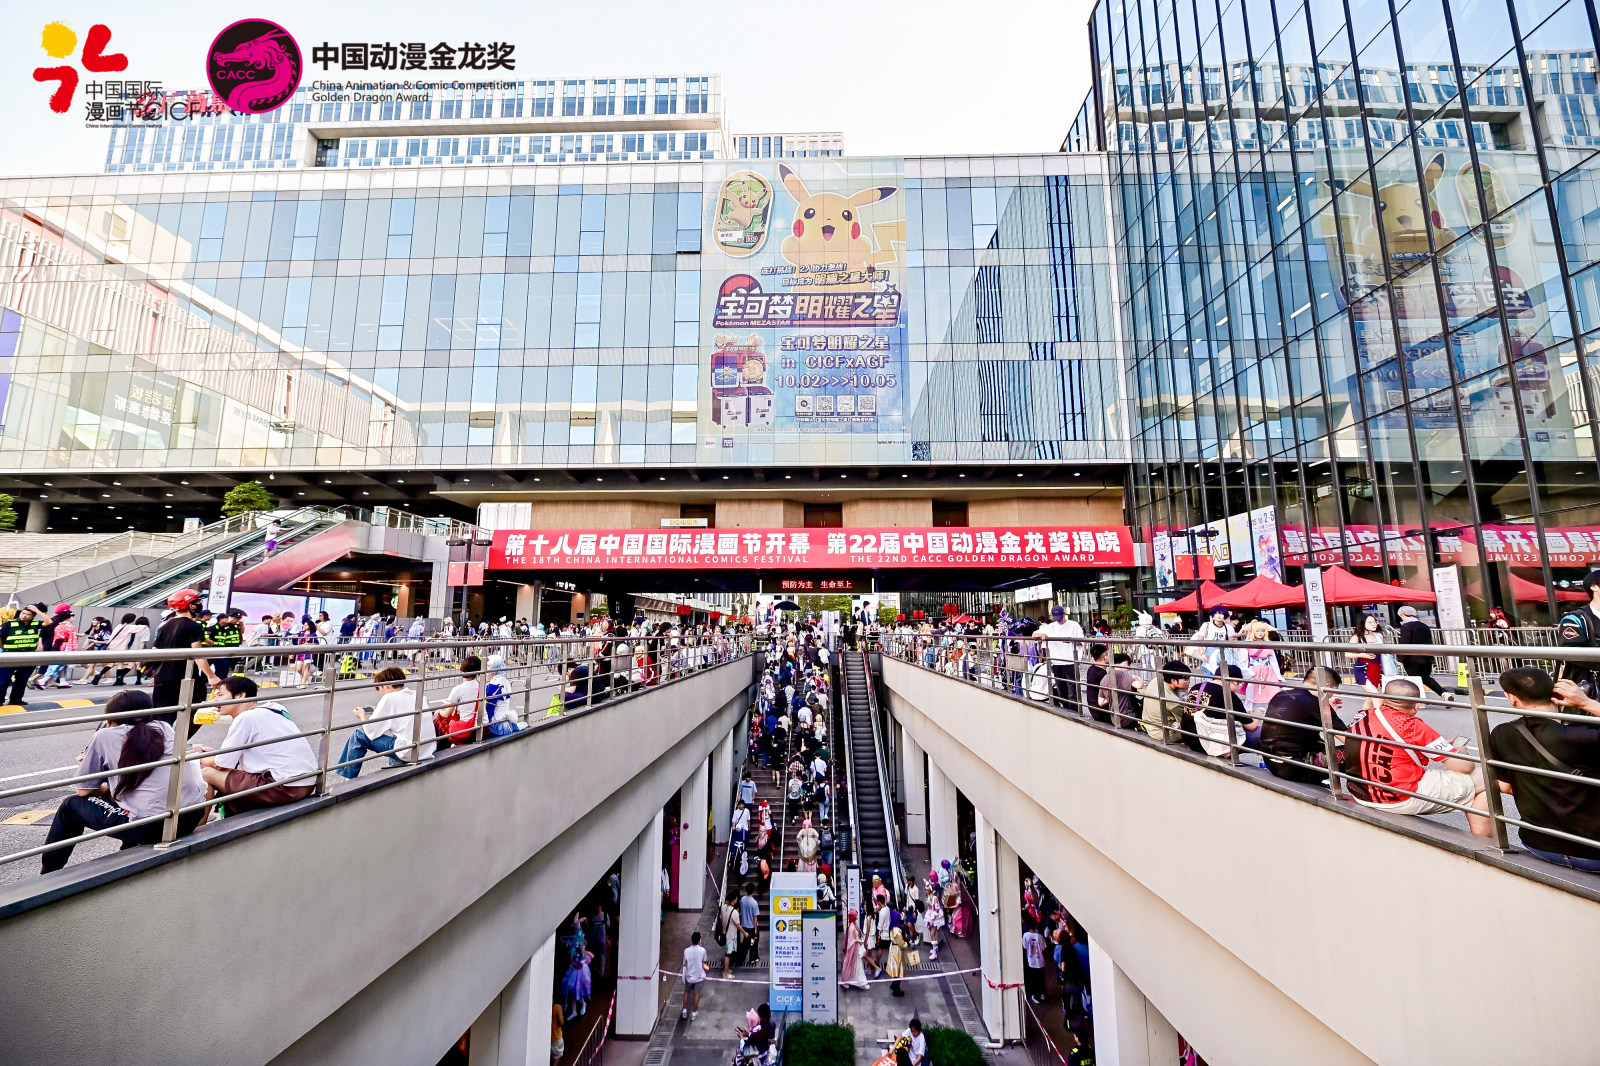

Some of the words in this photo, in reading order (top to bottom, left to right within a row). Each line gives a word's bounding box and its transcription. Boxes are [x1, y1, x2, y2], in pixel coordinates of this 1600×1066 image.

[718, 293, 899, 319] 宝可梦明耀之星
[781, 335, 890, 351] 宝可梦明耀之星
[782, 355, 796, 368] in
[805, 354, 890, 369] CICFxAGF
[504, 532, 811, 555] 第十八届中国国际漫画节开幕
[827, 530, 1121, 555] 第22届中国动漫金龙奖揭晓
[505, 556, 527, 565] THE
[532, 556, 560, 565] 18TH
[565, 556, 601, 565] CHINA
[606, 556, 699, 564] INTERNATIONAL
[704, 555, 748, 564] COMICS
[753, 555, 809, 563] FESTIVAL
[850, 554, 872, 563] THE
[878, 554, 907, 563] 22ND
[912, 554, 942, 563] CACC
[947, 554, 995, 563] GOLDEN
[1000, 554, 1049, 563] DRAGON
[1054, 554, 1095, 563] AWARD
[781, 580, 814, 589] 预防为主
[820, 580, 853, 589] 生命至上
